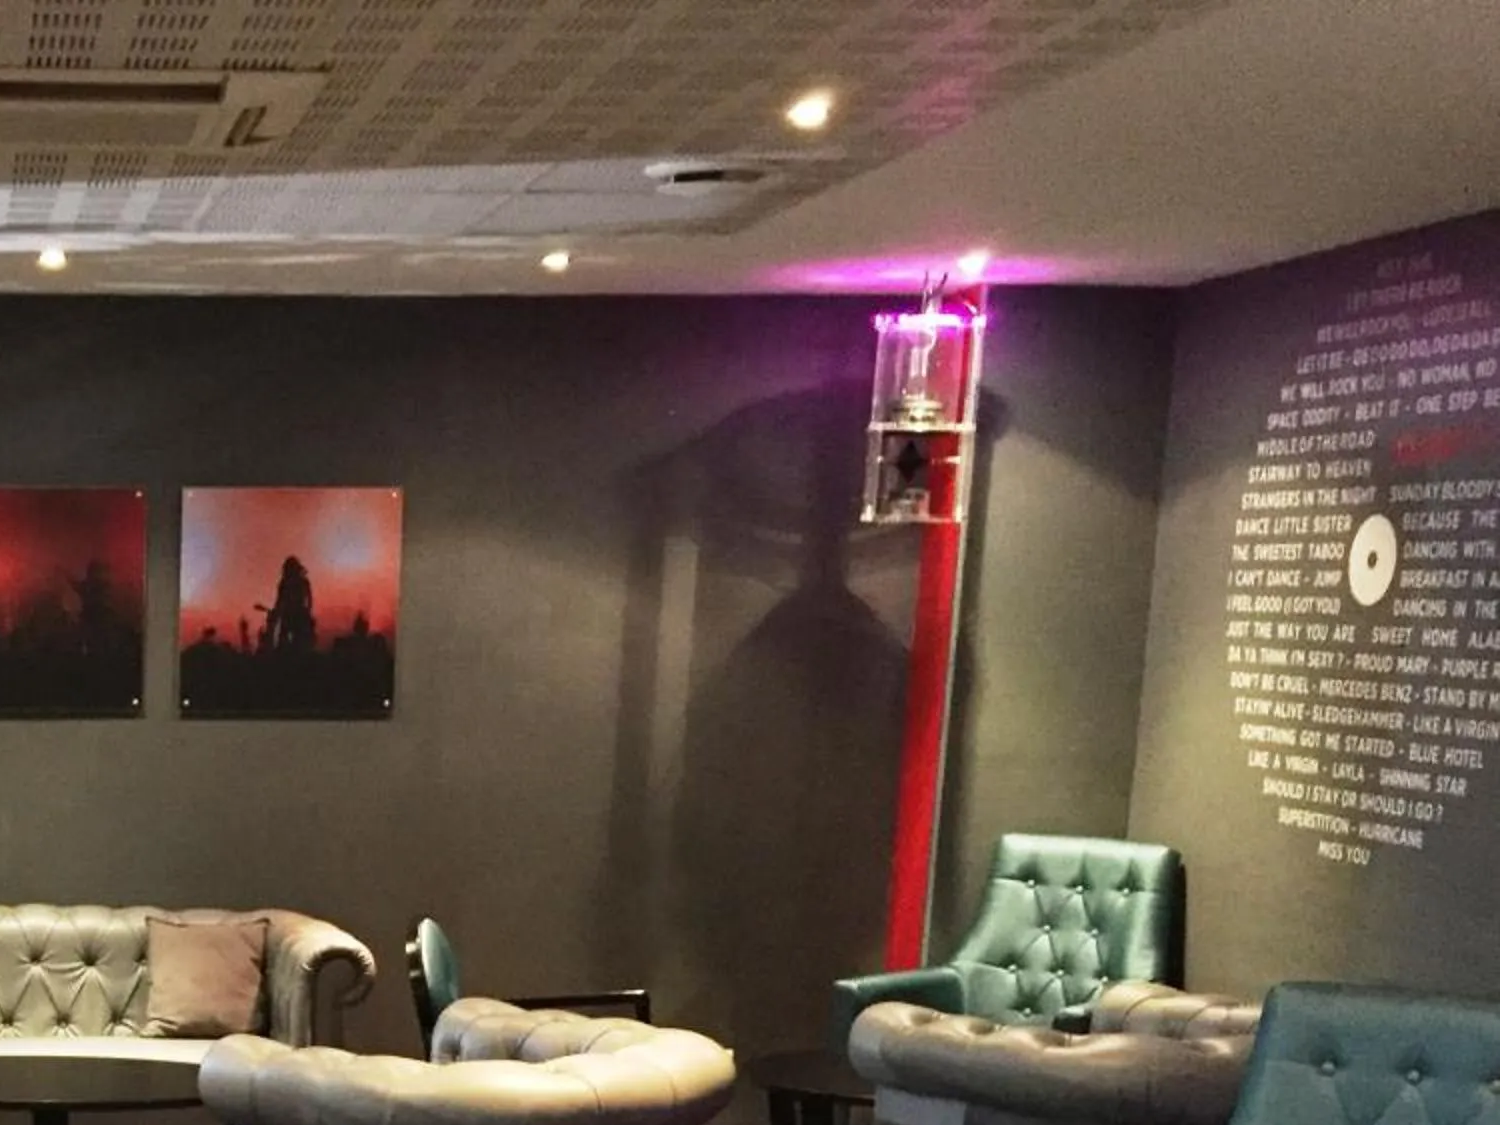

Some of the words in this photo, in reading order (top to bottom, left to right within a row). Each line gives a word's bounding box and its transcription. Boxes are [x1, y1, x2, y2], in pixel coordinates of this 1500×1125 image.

[1316, 434, 1338, 451] THE
[1339, 429, 1375, 449] ROAD
[1248, 464, 1301, 484] STAIRWAY
[1306, 460, 1321, 480] TO
[1325, 459, 1372, 479] HEAVEN
[1242, 489, 1301, 510] STRANGERS
[1317, 487, 1339, 506] THE
[1235, 517, 1269, 537] DANCE
[1273, 515, 1309, 535] LITTLE
[1313, 513, 1353, 533] SISTER
[1402, 510, 1460, 532] BECAUSE
[1472, 508, 1498, 529] THE
[1253, 543, 1303, 561] SWEETEST
[1308, 541, 1345, 561] TABOO
[1402, 540, 1458, 560] DANCING
[1463, 540, 1497, 559] WITH
[1266, 569, 1301, 588] DANCE
[1400, 569, 1469, 589] BREAKFAST
[1254, 595, 1283, 613] GOOD
[1393, 598, 1447, 618] DANCING
[1225, 620, 1250, 639] JUST
[1253, 621, 1273, 640] THE
[1277, 622, 1302, 641] WAY
[1306, 622, 1329, 642] YOU
[1333, 623, 1356, 644] ARE
[1372, 626, 1413, 646] SWEET
[1421, 628, 1459, 648] HOME
[1353, 652, 1394, 673] PROUD
[1395, 655, 1432, 674] MARY
[1441, 658, 1490, 680] PURPLE
[1276, 674, 1309, 695] CRUEL
[1320, 678, 1378, 700] MERCEDES
[1380, 682, 1413, 704] BENZ
[1422, 685, 1466, 708] STAND
[1273, 702, 1306, 721] ALIVE
[1312, 703, 1404, 731] SLEDGEHAMMER
[1413, 714, 1441, 735] LIKE
[1239, 722, 1297, 747] SOMETHING
[1299, 729, 1321, 748] GOT
[1344, 734, 1395, 759] STARTED
[1409, 742, 1441, 765] BLUE
[1443, 746, 1484, 770] HOTEL
[1332, 761, 1365, 783] LAYLA
[1435, 774, 1468, 797] STAR
[1262, 776, 1304, 801] SHOULD
[1312, 785, 1340, 806] STAY
[1340, 789, 1358, 809] OR
[1360, 791, 1406, 817] SHOULD
[1415, 800, 1433, 821] GO
[1278, 806, 1350, 835] SUPERSTITION
[1359, 821, 1424, 850] HURRICANE
[1318, 839, 1343, 862] MISS
[1346, 846, 1371, 866] YOU
